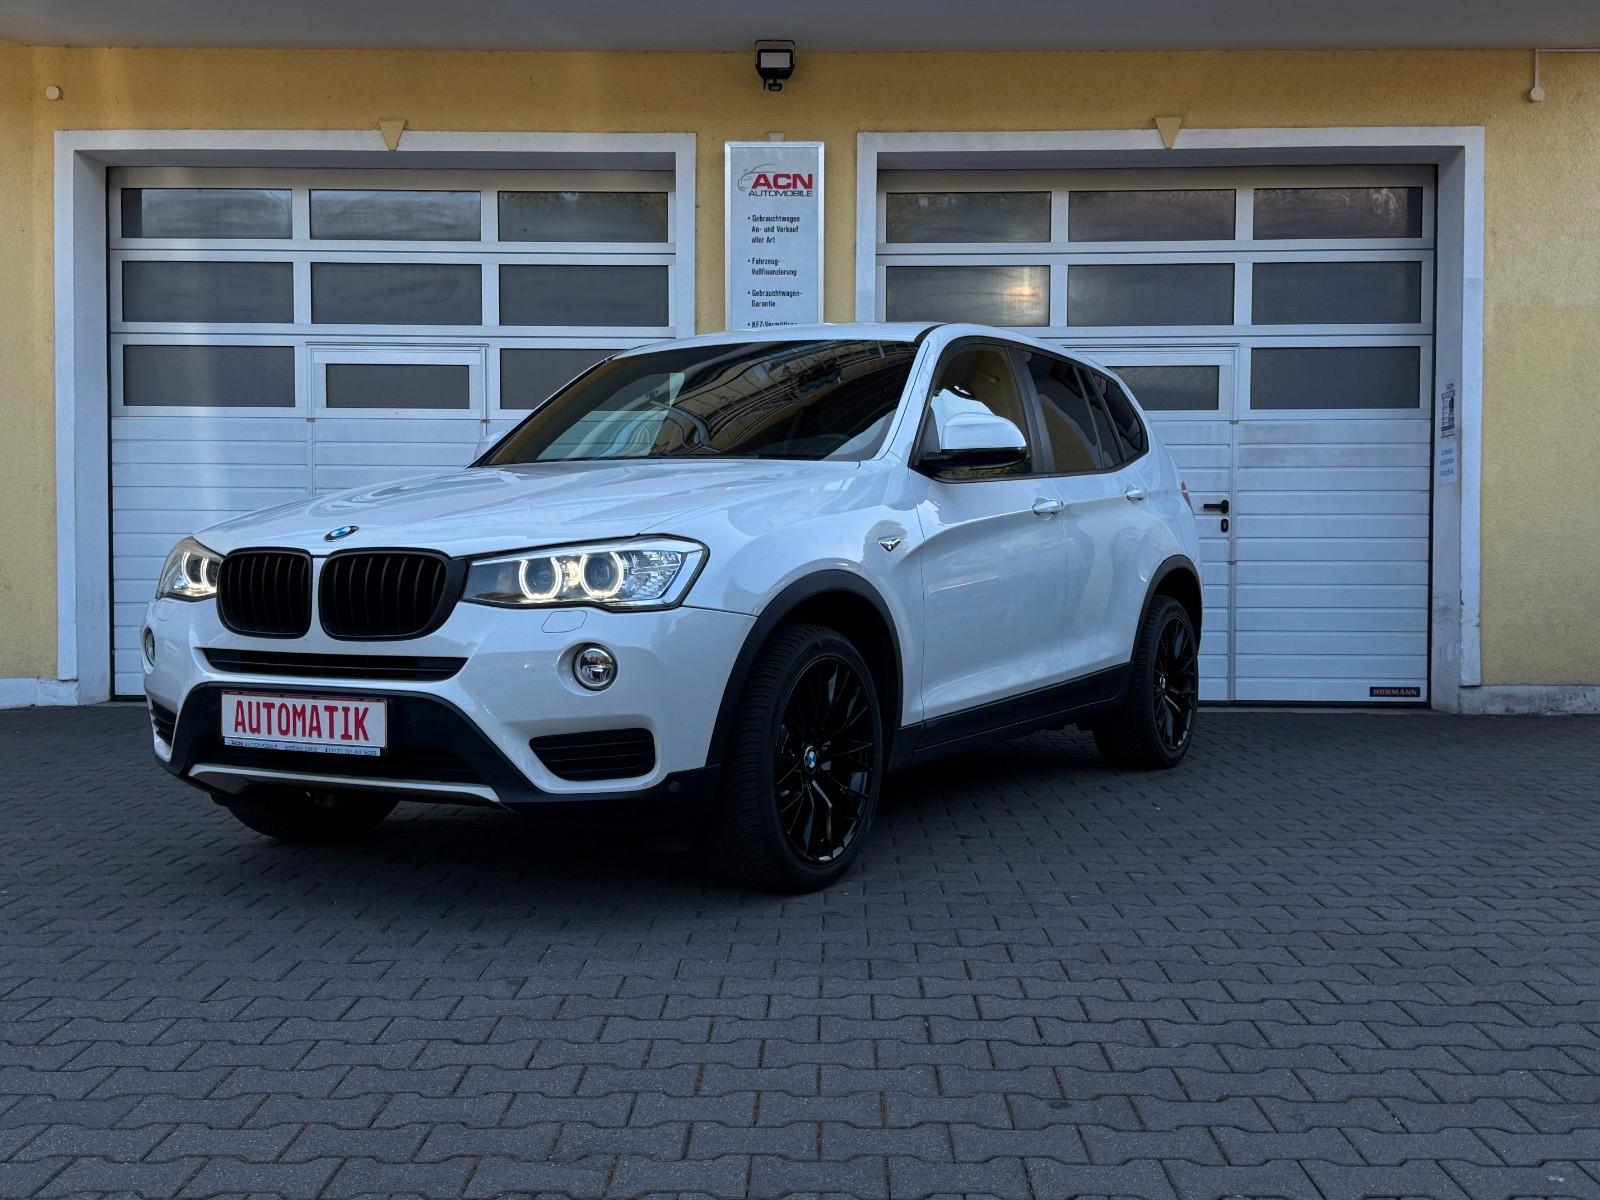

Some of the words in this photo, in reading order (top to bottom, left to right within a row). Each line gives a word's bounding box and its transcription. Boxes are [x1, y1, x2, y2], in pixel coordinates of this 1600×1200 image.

[751, 173, 813, 189] ACN
[752, 214, 801, 223] Gebrauchtwagen
[752, 225, 762, 233] An-
[764, 225, 775, 233] und
[776, 225, 799, 233] Verkauf
[752, 257, 781, 266] Fahrzeug-
[752, 268, 797, 277] Vollfinanzierung
[752, 289, 804, 298] Gebrauchtwagen-
[752, 299, 776, 307] Garantie
[234, 700, 370, 741] AUTOMATIK
